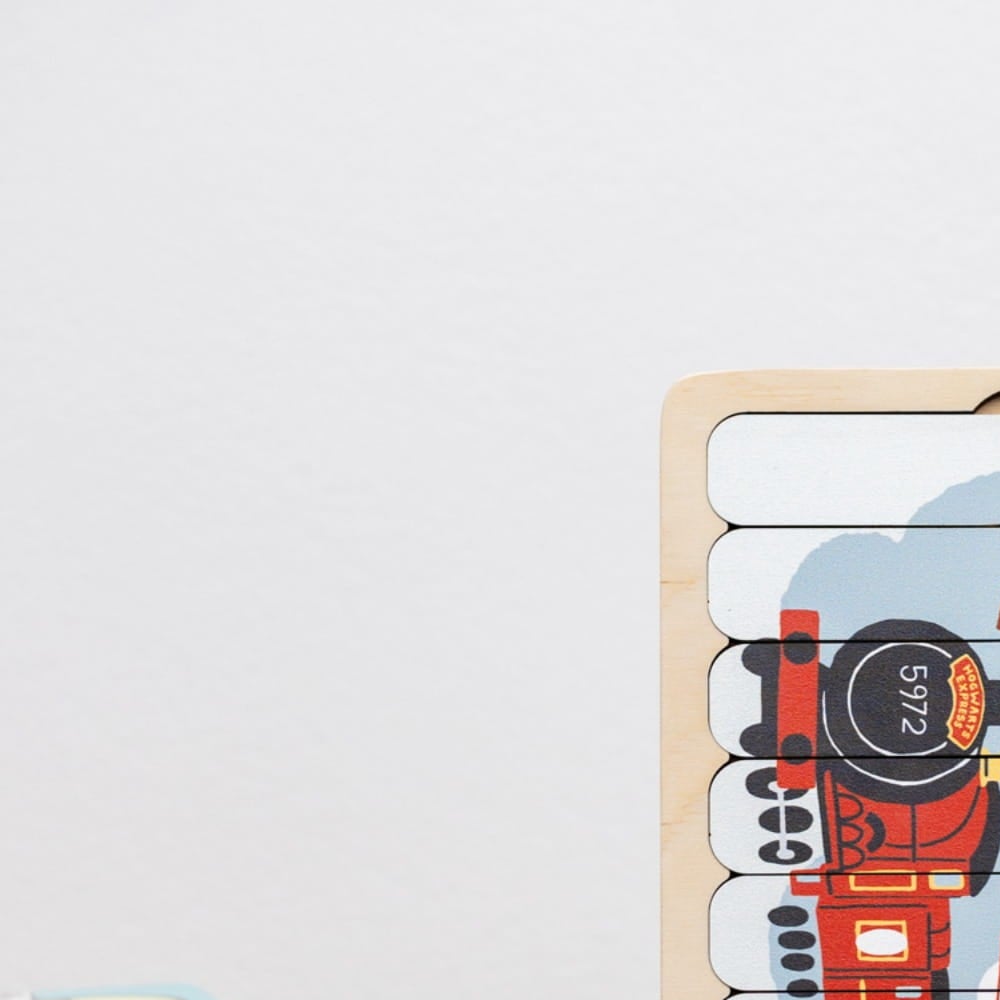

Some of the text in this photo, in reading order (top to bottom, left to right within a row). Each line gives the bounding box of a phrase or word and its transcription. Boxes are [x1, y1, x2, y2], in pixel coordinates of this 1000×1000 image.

[899, 665, 928, 735] 5972
[953, 674, 969, 729] EXPRESS
[961, 663, 980, 740] HOGWARTS
